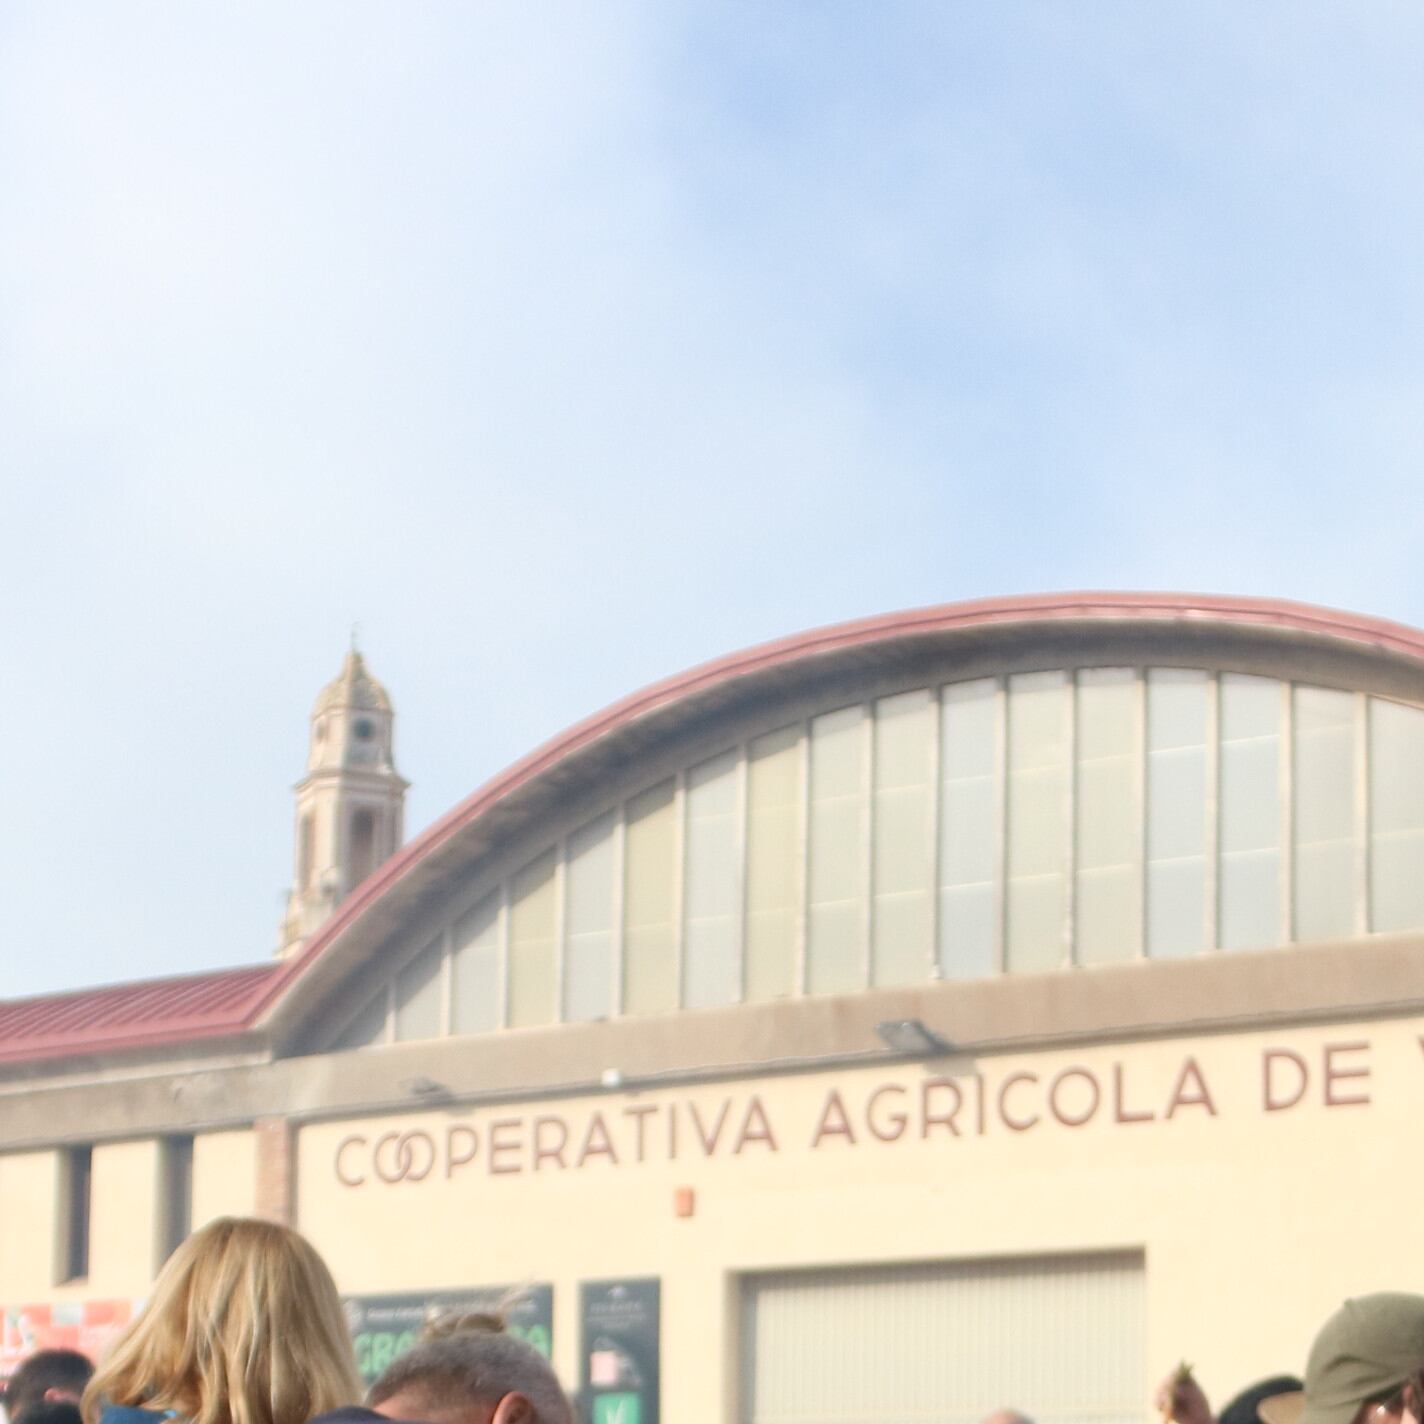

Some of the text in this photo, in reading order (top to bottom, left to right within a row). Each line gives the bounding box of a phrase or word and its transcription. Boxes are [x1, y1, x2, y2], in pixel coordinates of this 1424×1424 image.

[334, 1092, 779, 1187] COOPERATIVA
[811, 1055, 1218, 1149] AGRICOLA
[1262, 1039, 1372, 1113] DE
